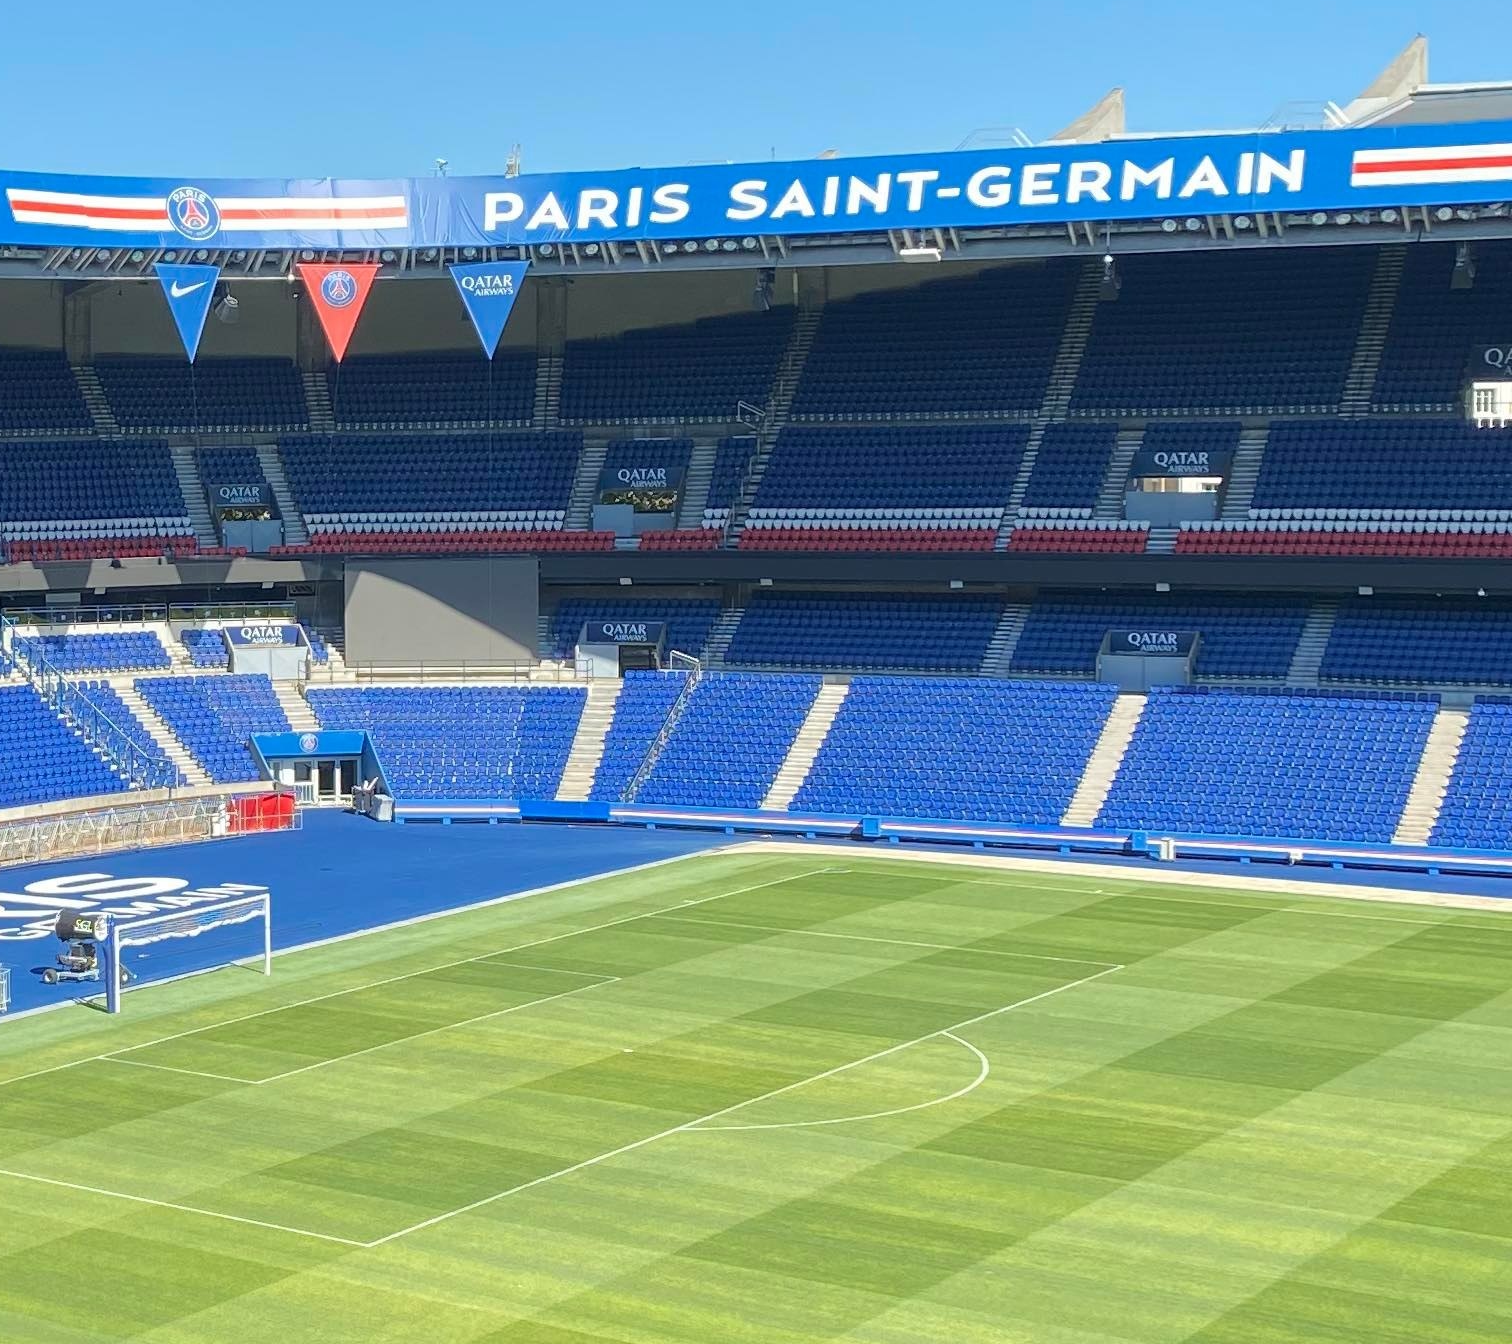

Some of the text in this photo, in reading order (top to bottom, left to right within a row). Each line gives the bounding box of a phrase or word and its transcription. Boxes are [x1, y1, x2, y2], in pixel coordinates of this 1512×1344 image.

[483, 149, 1306, 231] PARIS SAINT-GERMAIN
[461, 275, 513, 291] QATAR
[474, 287, 514, 296] AIRWAYS
[1154, 451, 1208, 467] QATAR
[617, 468, 666, 482] QATAR
[630, 479, 667, 488] AIRWAYS
[219, 486, 260, 499] QATAR
[240, 626, 283, 640] QATAR
[602, 623, 647, 636] QATAR
[1128, 632, 1177, 646] QATAR
